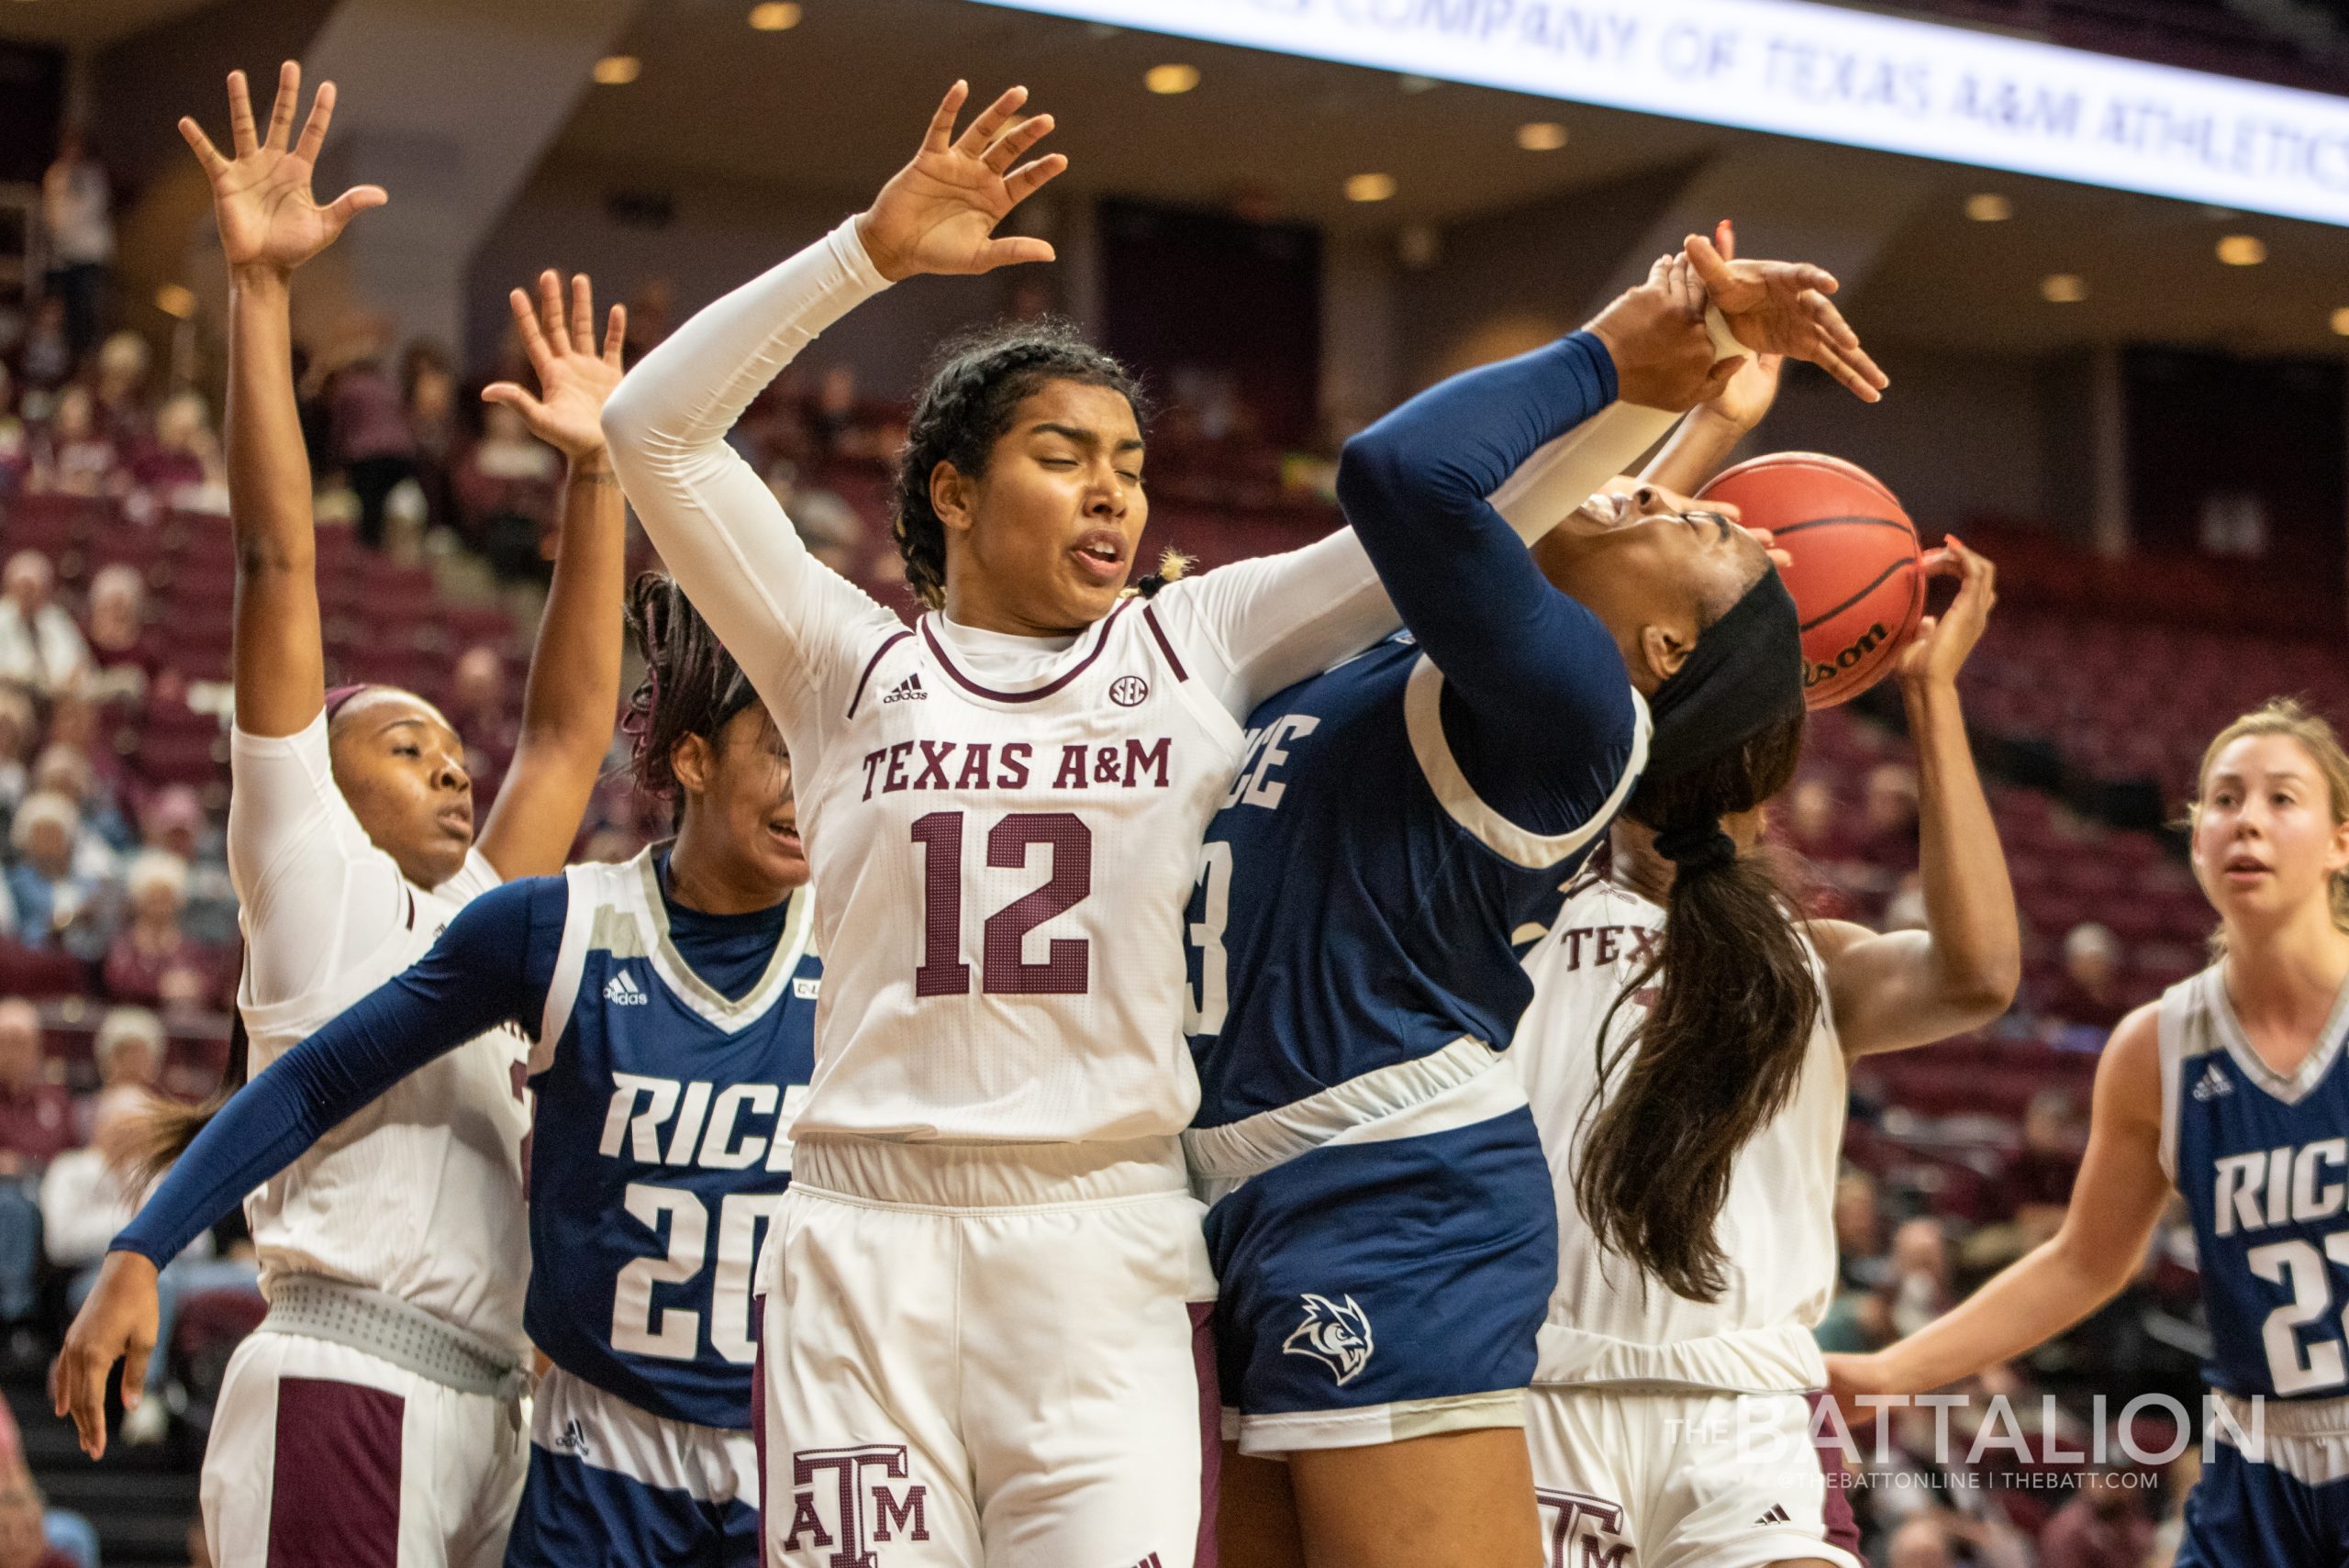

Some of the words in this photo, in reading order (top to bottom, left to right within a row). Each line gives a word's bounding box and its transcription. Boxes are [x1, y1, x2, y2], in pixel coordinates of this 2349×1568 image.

[1659, 18, 1741, 83] OF
[1764, 35, 1932, 121] TEXAS
[1951, 71, 2083, 139] A&M
[2098, 94, 2349, 195] ATHLETIC
[883, 688, 928, 704] adidas
[1109, 675, 1148, 707] SEC
[862, 740, 1033, 803] TEXAS
[1052, 737, 1172, 790] A&M
[910, 811, 1092, 997] 12
[2214, 1137, 2349, 1238] RIC
